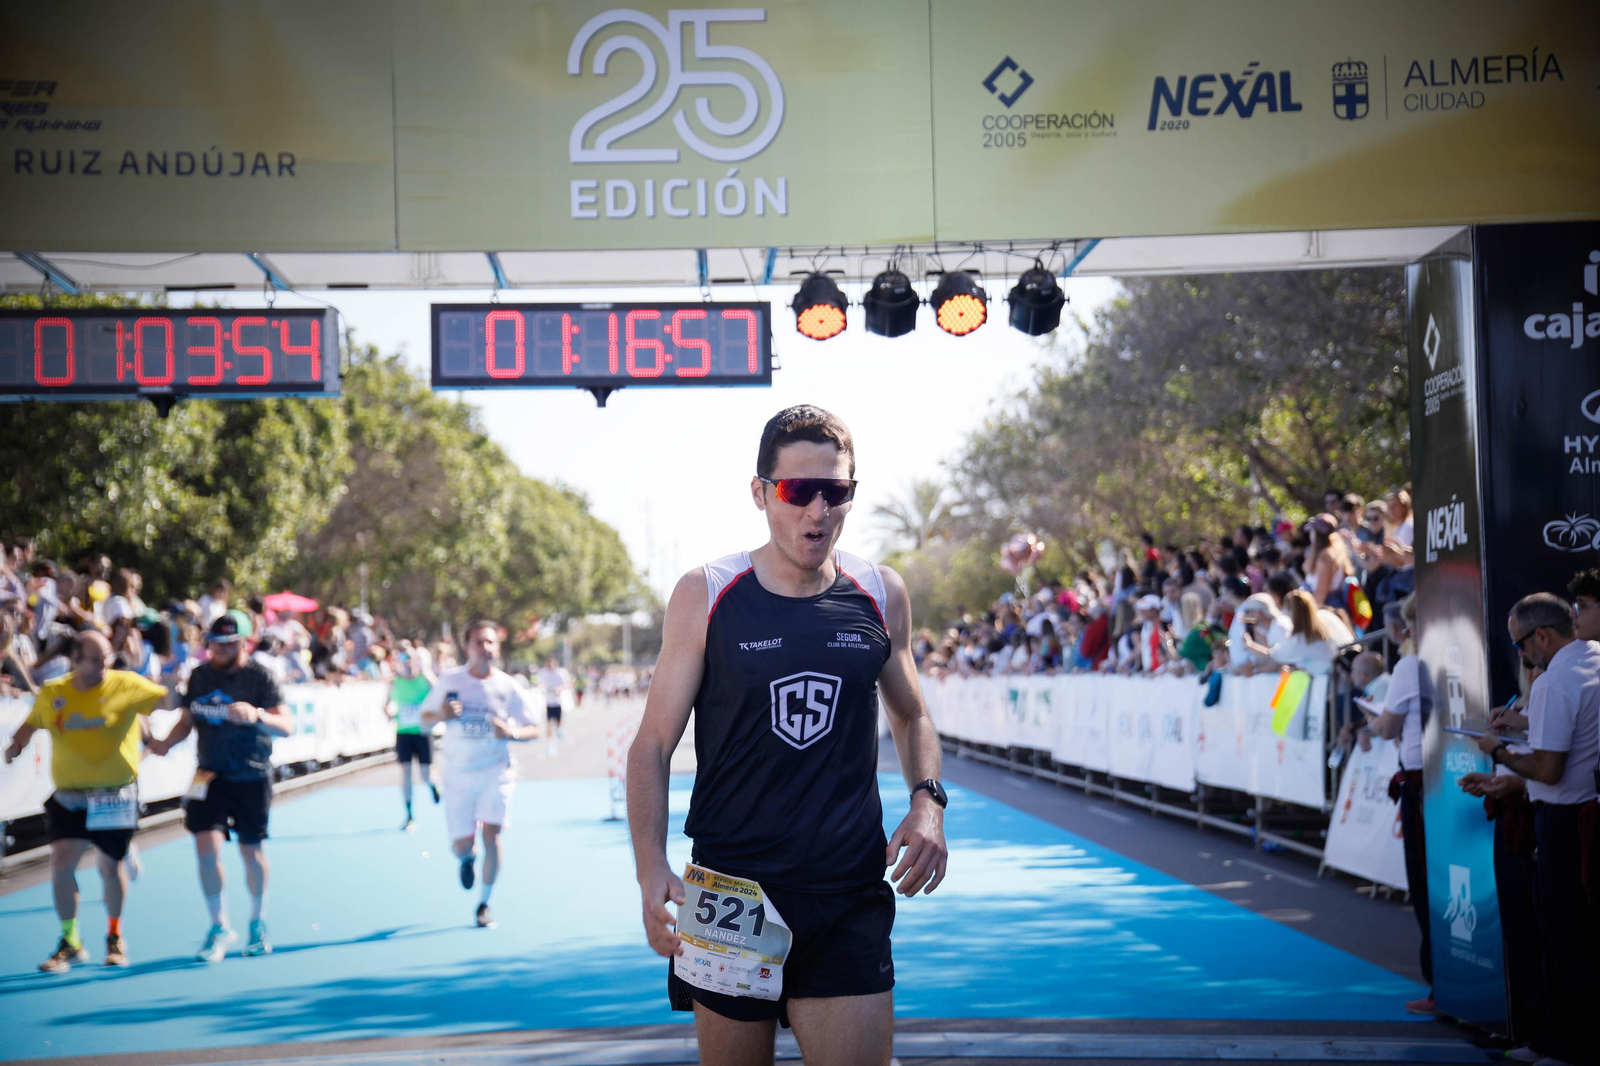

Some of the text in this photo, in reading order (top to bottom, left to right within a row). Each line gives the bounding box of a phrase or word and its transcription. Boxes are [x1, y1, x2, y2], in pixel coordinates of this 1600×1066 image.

[1403, 46, 1564, 88] ALMERÍA
[567, 8, 785, 162] 25
[1403, 90, 1485, 111] CIUDAD
[982, 109, 1114, 130] COOPERACIÓN
[1159, 120, 1190, 131] 2020
[982, 132, 1027, 148] 2005
[15, 146, 296, 177] RUIZ ANDÚJAR
[570, 168, 788, 218] EDICIÓN
[749, 638, 782, 649] TAKELOT
[836, 632, 862, 643] SEGURA
[848, 642, 870, 650] ATLETISMO
[739, 886, 758, 897] 2024
[694, 889, 767, 938] 521
[704, 927, 747, 945] NANDEZ
